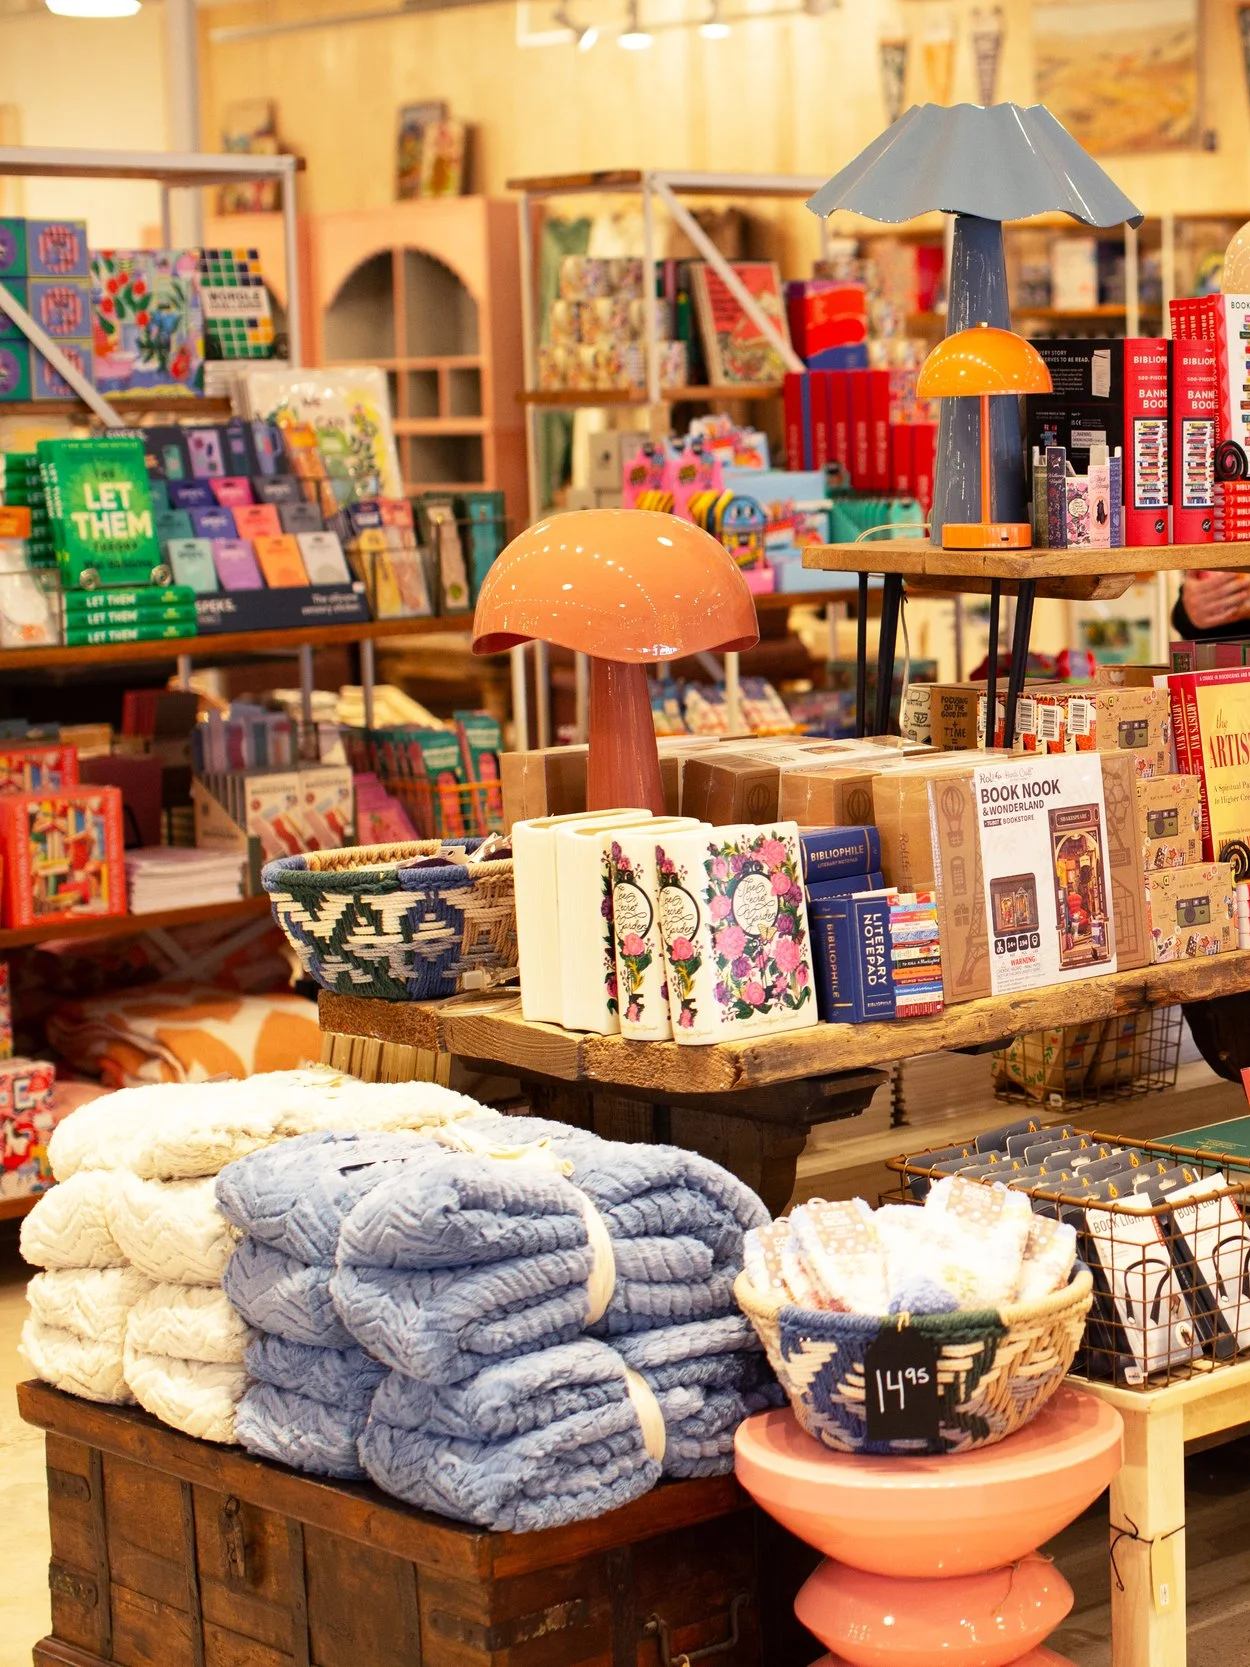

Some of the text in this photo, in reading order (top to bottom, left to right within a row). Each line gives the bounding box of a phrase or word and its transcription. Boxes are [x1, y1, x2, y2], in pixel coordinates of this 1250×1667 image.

[83, 481, 132, 510] LET
[71, 510, 152, 540] THEM
[87, 593, 136, 608] LET THEM
[88, 610, 137, 626] LET THEM
[88, 629, 137, 644] LET THEM
[1172, 703, 1186, 750] ARTIST'S WAY
[1186, 703, 1200, 749] ARTIST'S WAY
[1216, 709, 1228, 728] the
[944, 727, 966, 738] TIME
[981, 779, 1061, 804] BOOK NOOK
[1218, 783, 1241, 794] Spiritual
[989, 800, 1044, 815] WONDERLAND
[1221, 796, 1239, 805] Higher
[1003, 815, 1035, 825] BOOKSTORE
[1201, 808, 1210, 839] CAMERON
[810, 844, 864, 861] BIBLIOPHILE
[838, 857, 858, 865] NOTEPAD
[738, 877, 766, 897] The
[743, 891, 768, 904] Secret
[863, 914, 877, 986] NOTEPAD
[873, 913, 887, 985] LITERARY
[826, 924, 840, 998] BIBLIOPHILE
[1093, 1214, 1145, 1233] BOOK LIGHT
